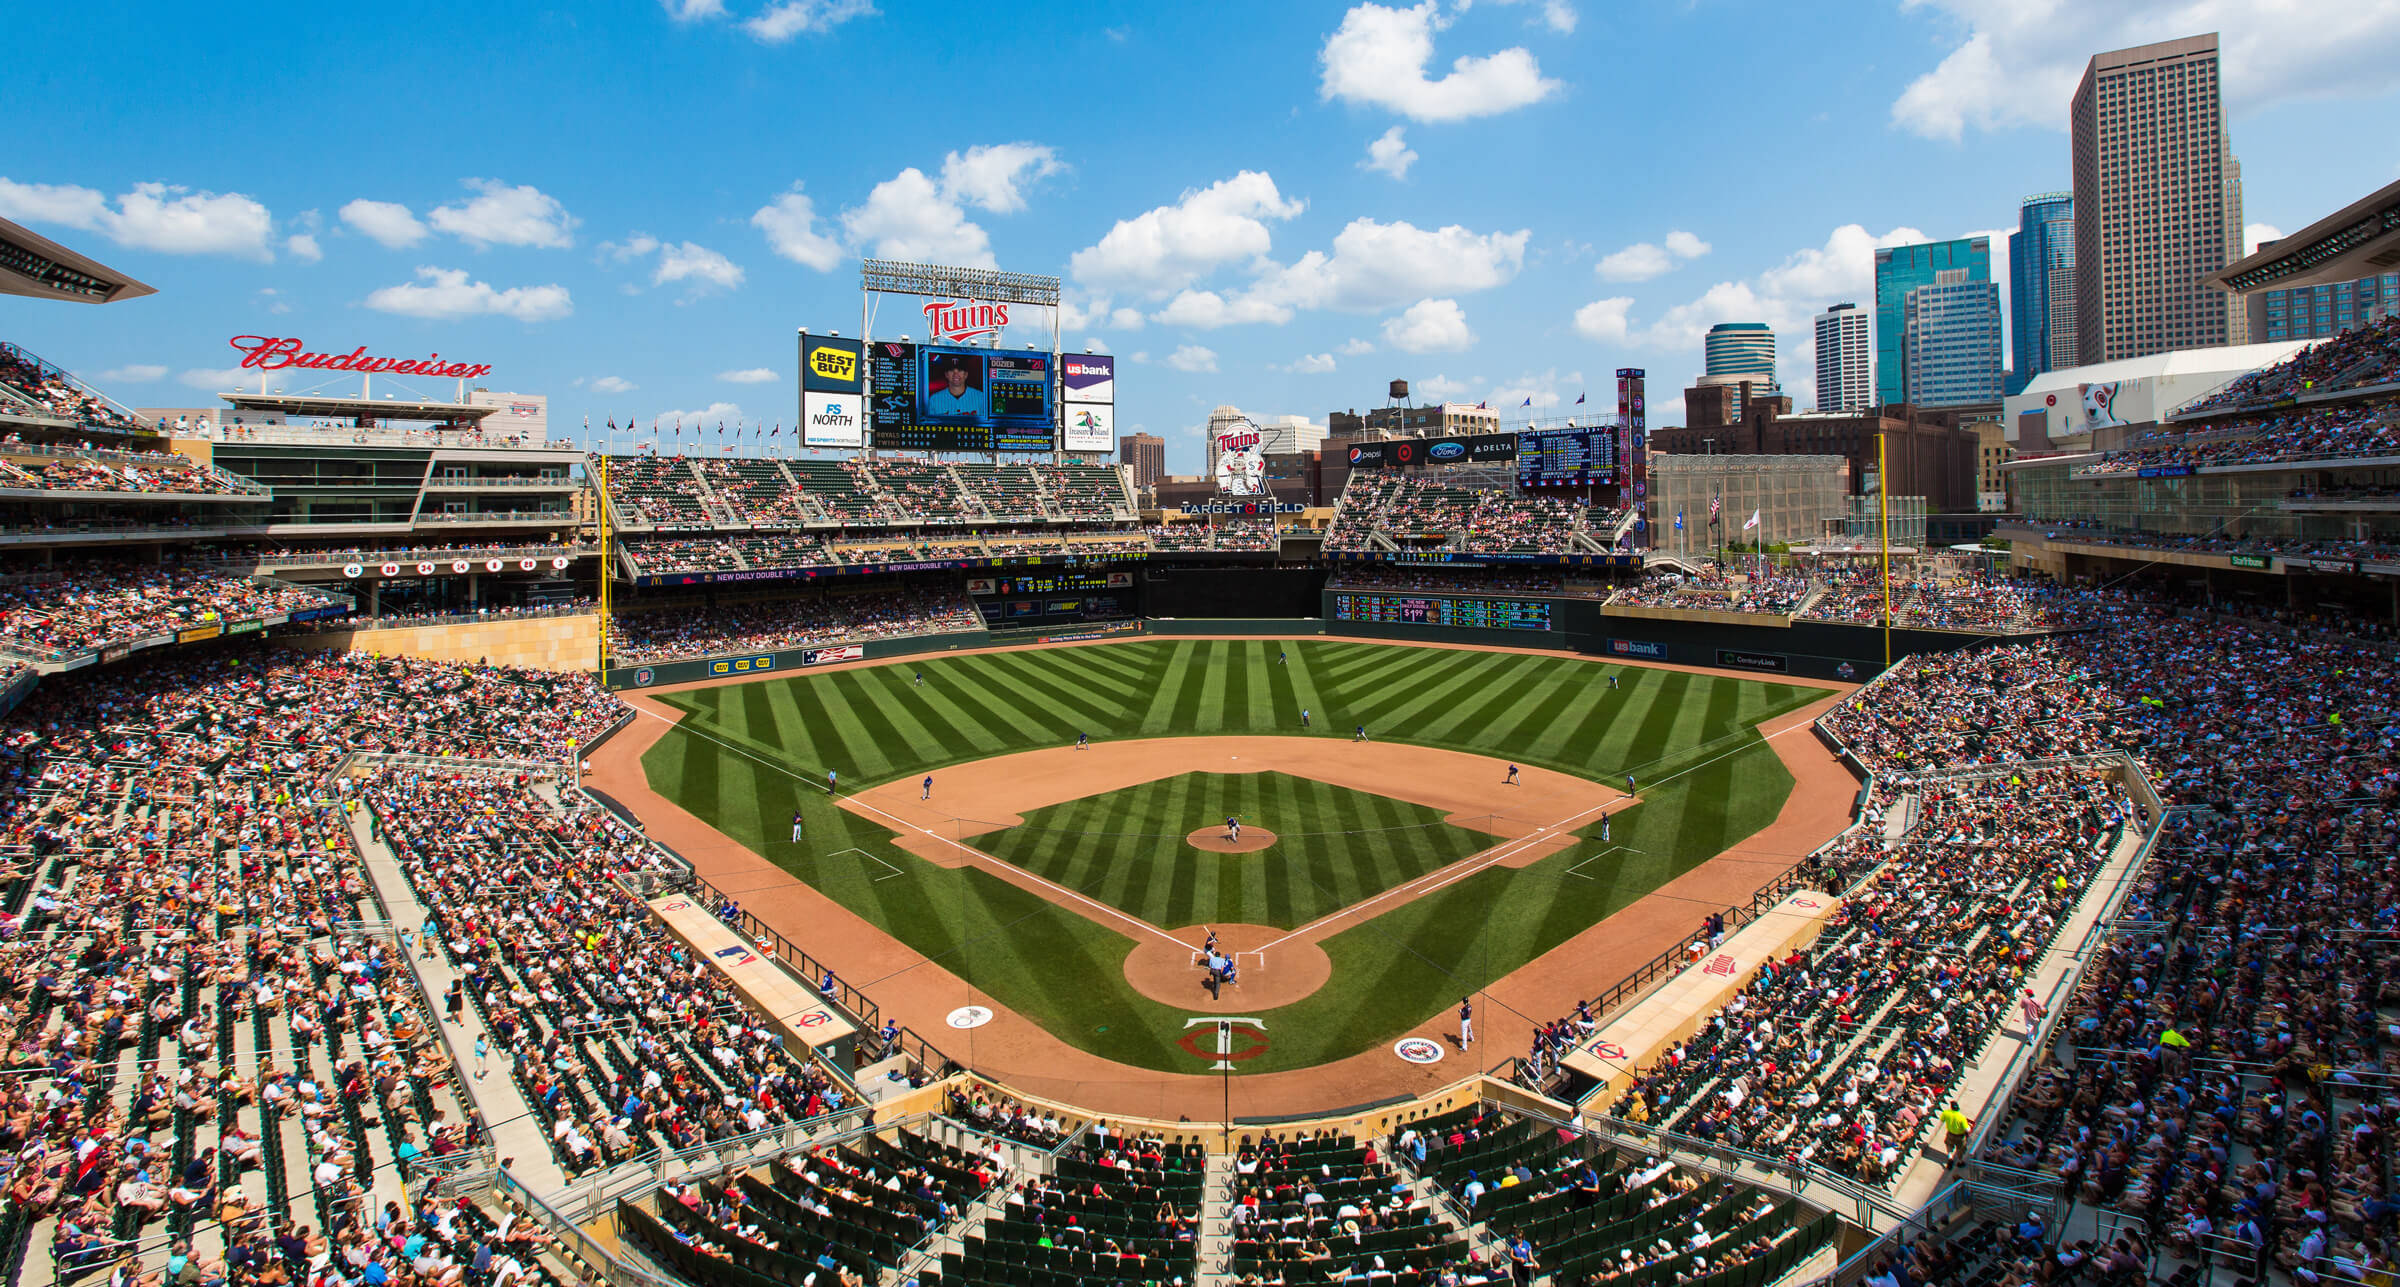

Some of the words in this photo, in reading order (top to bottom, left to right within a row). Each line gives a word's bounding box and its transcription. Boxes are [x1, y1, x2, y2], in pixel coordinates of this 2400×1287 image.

[924, 299, 1008, 337] Twins
[230, 335, 492, 378] Budweiser
[816, 352, 854, 366] BEST
[817, 362, 850, 376] BUY
[992, 360, 1014, 368] DOZIER
[1032, 360, 1043, 369] 20
[1067, 364, 1111, 376] usbank
[826, 404, 842, 415] FS
[813, 414, 852, 426] NORTH
[1633, 416, 1644, 427] VS
[1069, 425, 1089, 436] Treasure
[1094, 426, 1109, 436] Island
[1217, 431, 1260, 453] Twins
[1483, 443, 1512, 452] DELTA
[1363, 450, 1381, 460] pepsi
[1436, 446, 1458, 456] Ford
[1181, 505, 1243, 514] TARGET
[1259, 504, 1304, 513] FIELD
[717, 574, 734, 582] NEW
[756, 571, 783, 579] DOUBLE
[1049, 602, 1079, 610] SUBWAY
[1614, 640, 1659, 655] usbank
[1737, 656, 1776, 666] CenturyLink
[1703, 954, 1734, 977] Twins
